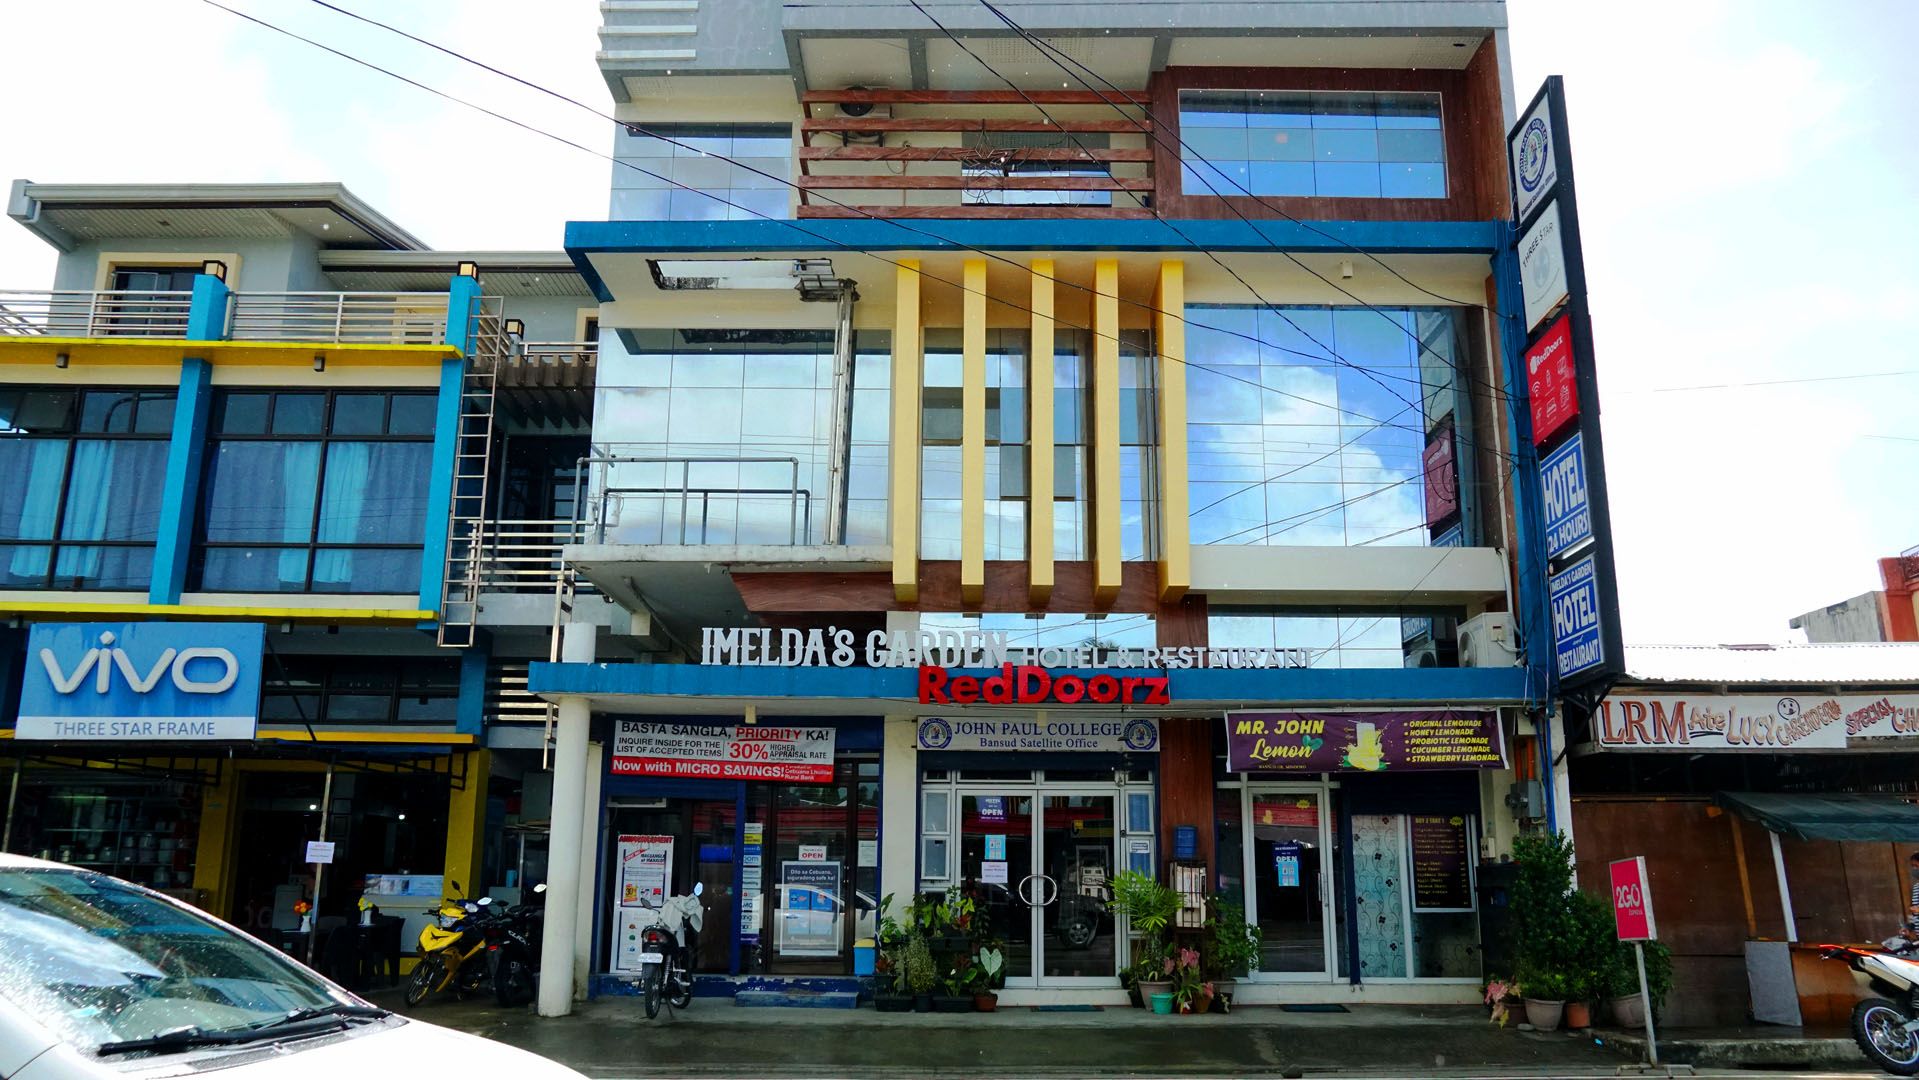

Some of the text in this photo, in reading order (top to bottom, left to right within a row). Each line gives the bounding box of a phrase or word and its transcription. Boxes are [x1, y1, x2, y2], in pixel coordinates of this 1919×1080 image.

[1522, 222, 1554, 268] THREE STAR
[1542, 452, 1584, 525] HOTEL
[1548, 510, 1588, 553] 24 HOURS
[1570, 562, 1593, 582] GARDEN
[1554, 585, 1596, 639] HOTEL
[700, 625, 1314, 670] IMELDA'S GARDEN HOTEL & RESTAURANT
[1559, 638, 1599, 675] RESTAURANT
[918, 661, 1171, 705] RedDoorz
[1600, 700, 1690, 745] LRM
[1688, 704, 1727, 731] Ate
[1845, 697, 1919, 736] SPECIAL CH
[54, 721, 216, 736] THREE STAR FRAME
[621, 722, 829, 740] BASTA SANGLA, PRIORITY KA!
[955, 722, 1122, 736] JOHN PAUL COLLEGE
[1236, 720, 1325, 735] MR. JOHN
[616, 745, 634, 753] LIST
[649, 747, 695, 756] ACCEPTED
[696, 749, 722, 757] ITEMS
[619, 737, 721, 749] INQUIRE INSIDE FOR THE
[770, 744, 796, 752] HIGHER
[980, 738, 1098, 748] Bansud Satellite Office
[1249, 738, 1314, 761] Lemon
[769, 751, 807, 759] APPRAISAL
[809, 751, 828, 759] RATE
[613, 760, 785, 777] Now with MICRO SAVINGS!
[981, 808, 1003, 816] OPEN
[1276, 855, 1298, 863] OPEN
[1615, 883, 1641, 909] 2GO
